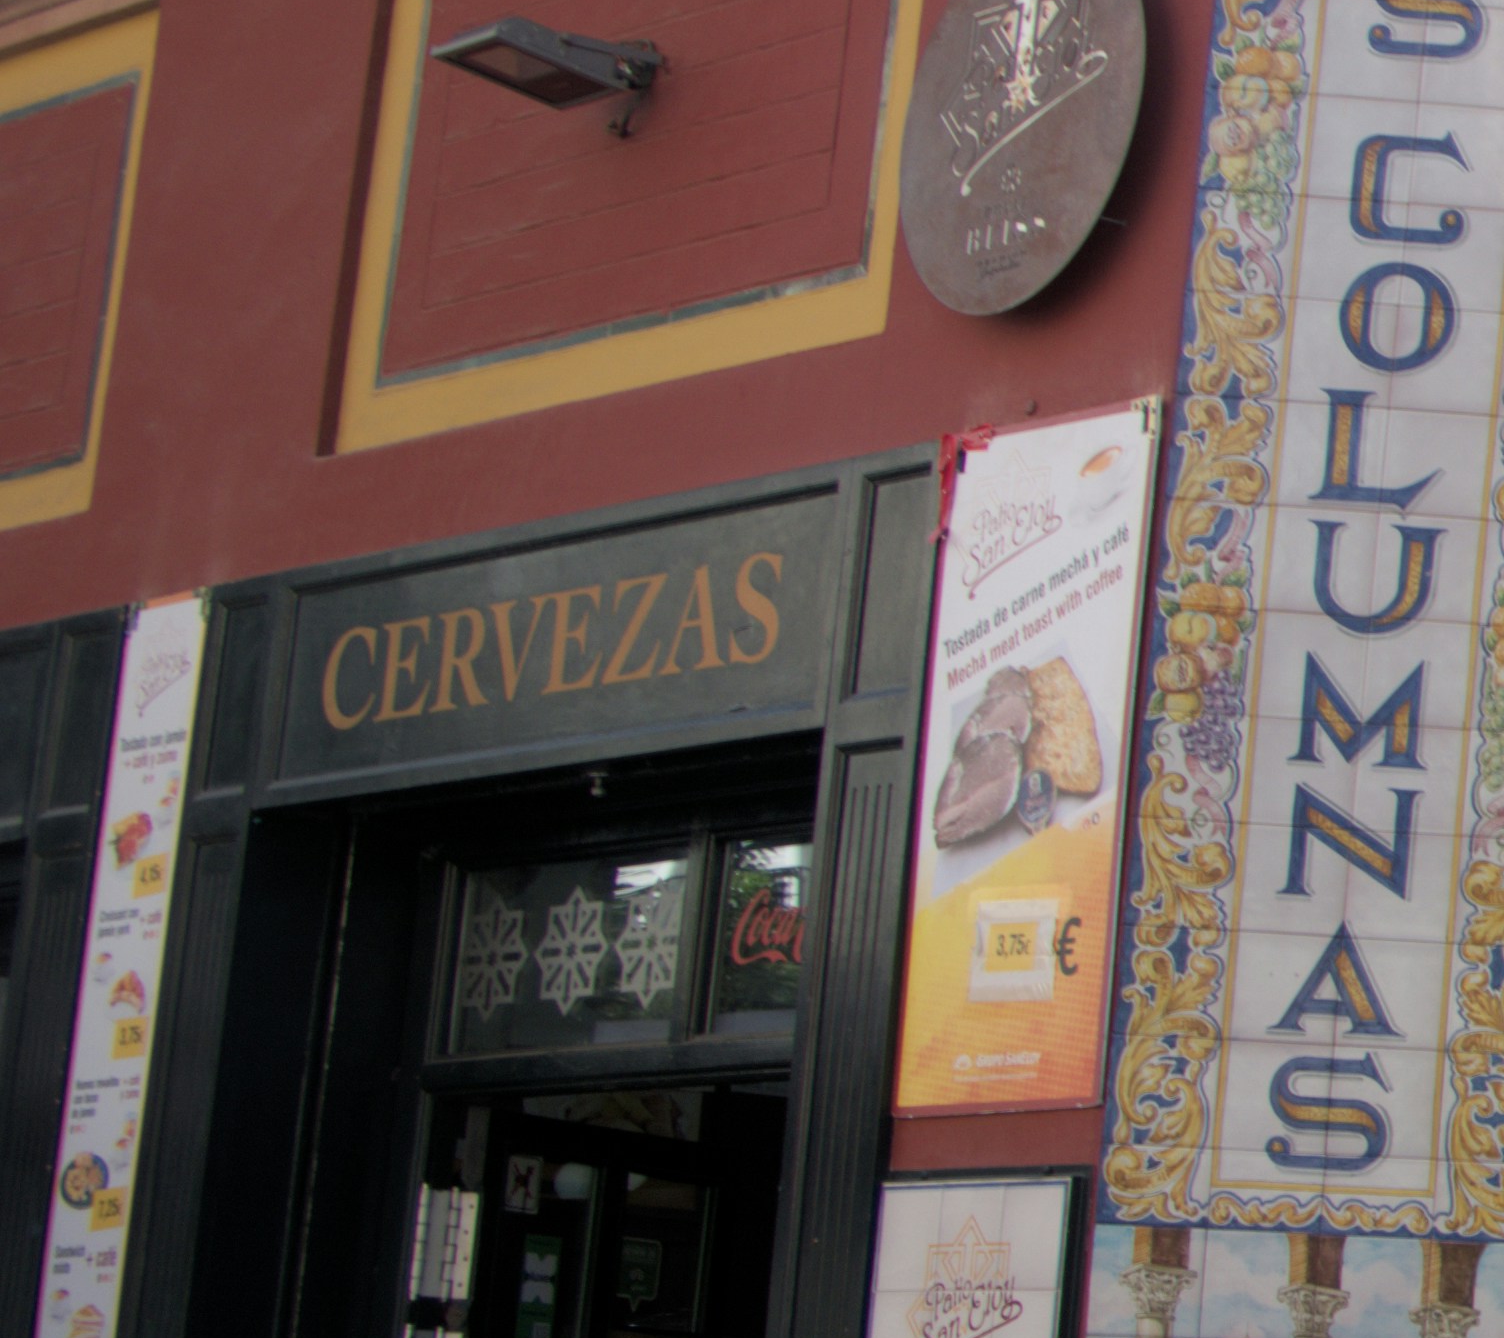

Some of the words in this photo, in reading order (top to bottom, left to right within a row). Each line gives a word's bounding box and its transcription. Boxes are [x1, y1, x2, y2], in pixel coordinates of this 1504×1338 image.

[321, 551, 784, 732] CERVEZAS
[943, 615, 992, 659] Tostada
[994, 603, 1009, 628] de
[1011, 581, 1046, 615] carne
[1091, 545, 1100, 567] y
[1103, 523, 1131, 558] café
[989, 629, 1020, 661] meat
[1022, 606, 1054, 644] toast
[1055, 588, 1083, 620] with
[1086, 562, 1124, 601] coffee
[1264, 131, 1472, 1169] COLUMNAS
[925, 1276, 971, 1323] Patio
[967, 1276, 1023, 1334] Eloy
